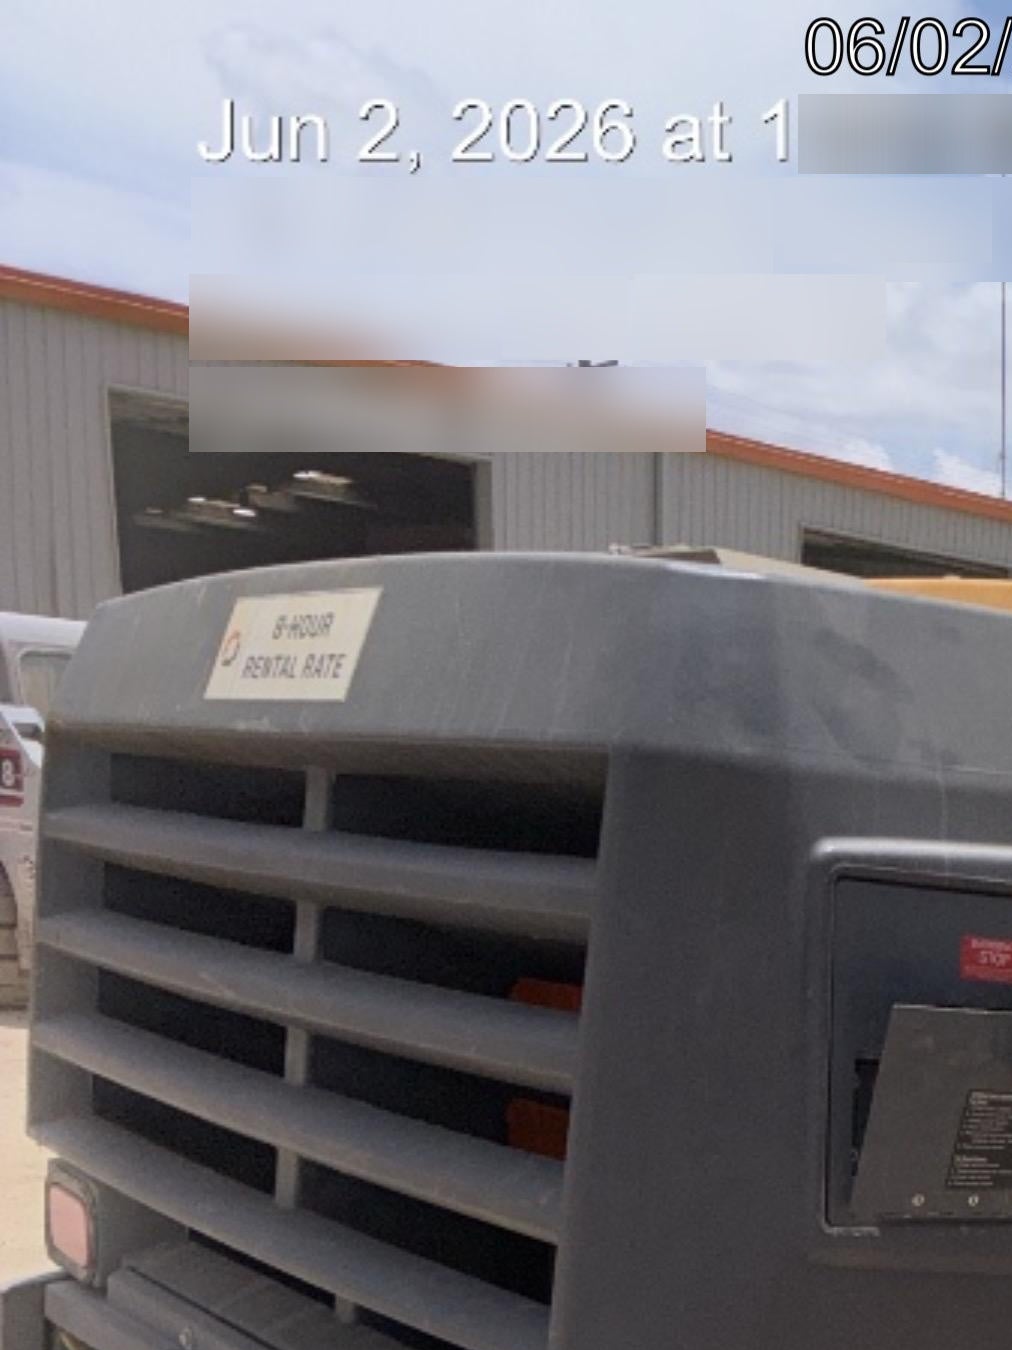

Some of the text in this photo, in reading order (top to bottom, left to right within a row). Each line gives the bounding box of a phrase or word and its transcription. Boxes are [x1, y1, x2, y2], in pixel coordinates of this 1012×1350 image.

[272, 612, 335, 640] 8-HOUR
[241, 653, 346, 679] RENTAL RATE
